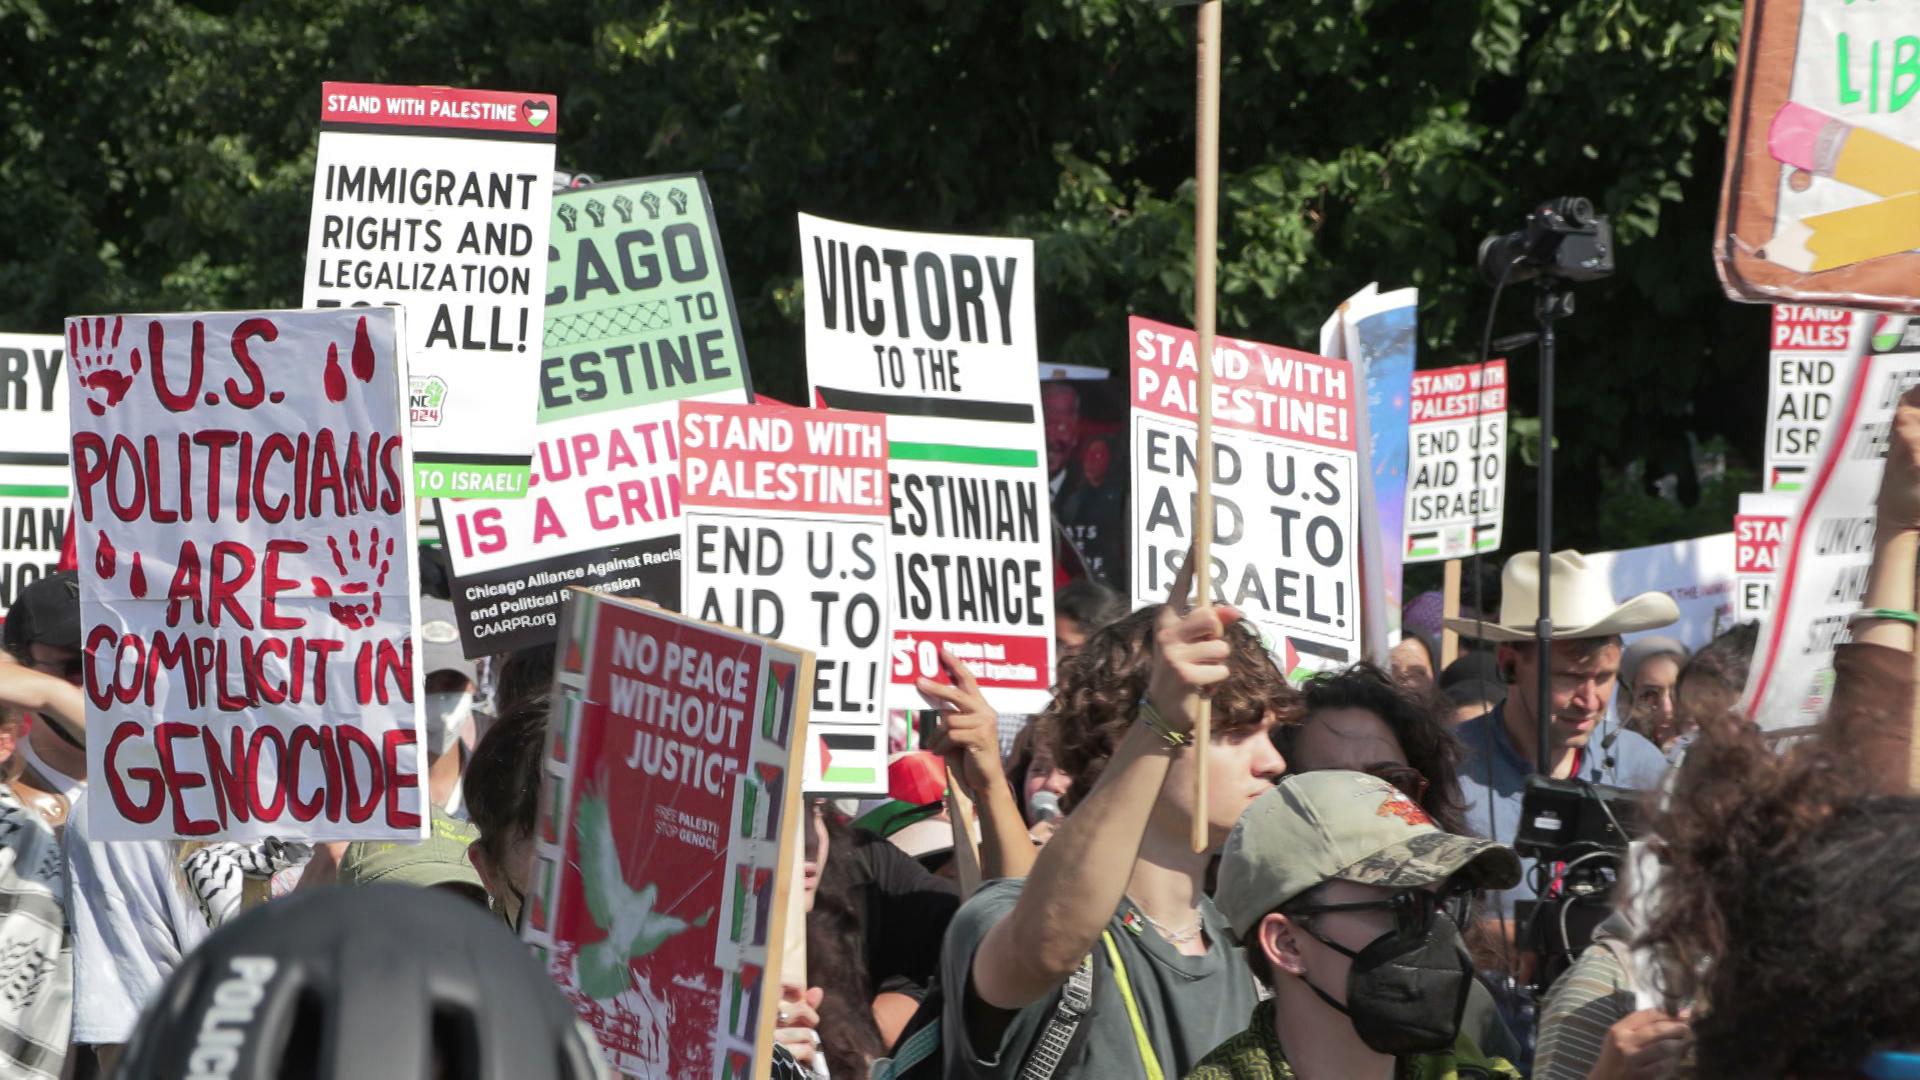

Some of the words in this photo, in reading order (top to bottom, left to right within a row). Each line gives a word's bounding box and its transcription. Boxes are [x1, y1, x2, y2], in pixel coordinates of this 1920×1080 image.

[327, 94, 381, 114] STAND
[386, 97, 425, 116] WITH
[430, 100, 517, 121] PALESTINE
[325, 164, 537, 210] IMMIGRANT
[322, 215, 442, 253] RIGHTS
[457, 221, 533, 256] AND
[318, 259, 531, 296] LEGALIZATION
[813, 235, 1018, 346] VICTORY
[425, 303, 529, 353] ALL!
[676, 291, 719, 323] TO
[1775, 304, 1845, 322] STAND
[148, 318, 286, 412] U.S.
[874, 345, 905, 389] TO
[913, 347, 961, 392] THE
[1261, 354, 1347, 400] WITH
[1411, 372, 1466, 396] STAND
[1469, 365, 1505, 390] WITH
[1780, 360, 1835, 385] END
[1411, 386, 1505, 421] PALESTINE!
[1776, 392, 1832, 421] AID
[528, 419, 678, 488] UPATI
[684, 413, 793, 452] STAND
[804, 421, 881, 458] WITH
[1417, 429, 1459, 458] END
[72, 428, 403, 524] POLITICIANS
[418, 469, 444, 490] TO
[451, 470, 522, 492] ISRAEL!
[687, 459, 884, 506] PALESTINE!
[1147, 428, 1242, 486] END
[1266, 451, 1341, 506] U.S
[1413, 460, 1459, 490] AID
[1470, 453, 1498, 484] TO
[1411, 486, 1498, 522] ISRAEL!
[456, 507, 508, 559] IS
[533, 496, 567, 544] A
[1270, 505, 1344, 568] TO
[697, 525, 784, 576] END
[807, 530, 876, 580] U.S
[166, 539, 308, 631] ARE
[465, 578, 526, 601] Chicago
[528, 566, 585, 588] Alliance
[587, 554, 641, 578] Against
[470, 604, 499, 621] and
[501, 591, 558, 615] Political
[473, 612, 557, 639] CAARPR.org
[700, 586, 784, 640] AID
[810, 591, 880, 649] TO
[82, 624, 344, 711] COMPLICIT
[354, 636, 415, 706] IN
[611, 626, 660, 676] NO
[662, 641, 750, 704] PEACE
[609, 672, 744, 749] WITHOUT
[104, 720, 422, 836] GENOCIDE
[678, 811, 720, 838] PALESTI
[679, 828, 718, 855] GENOCI
[184, 956, 277, 1080] POLIC
